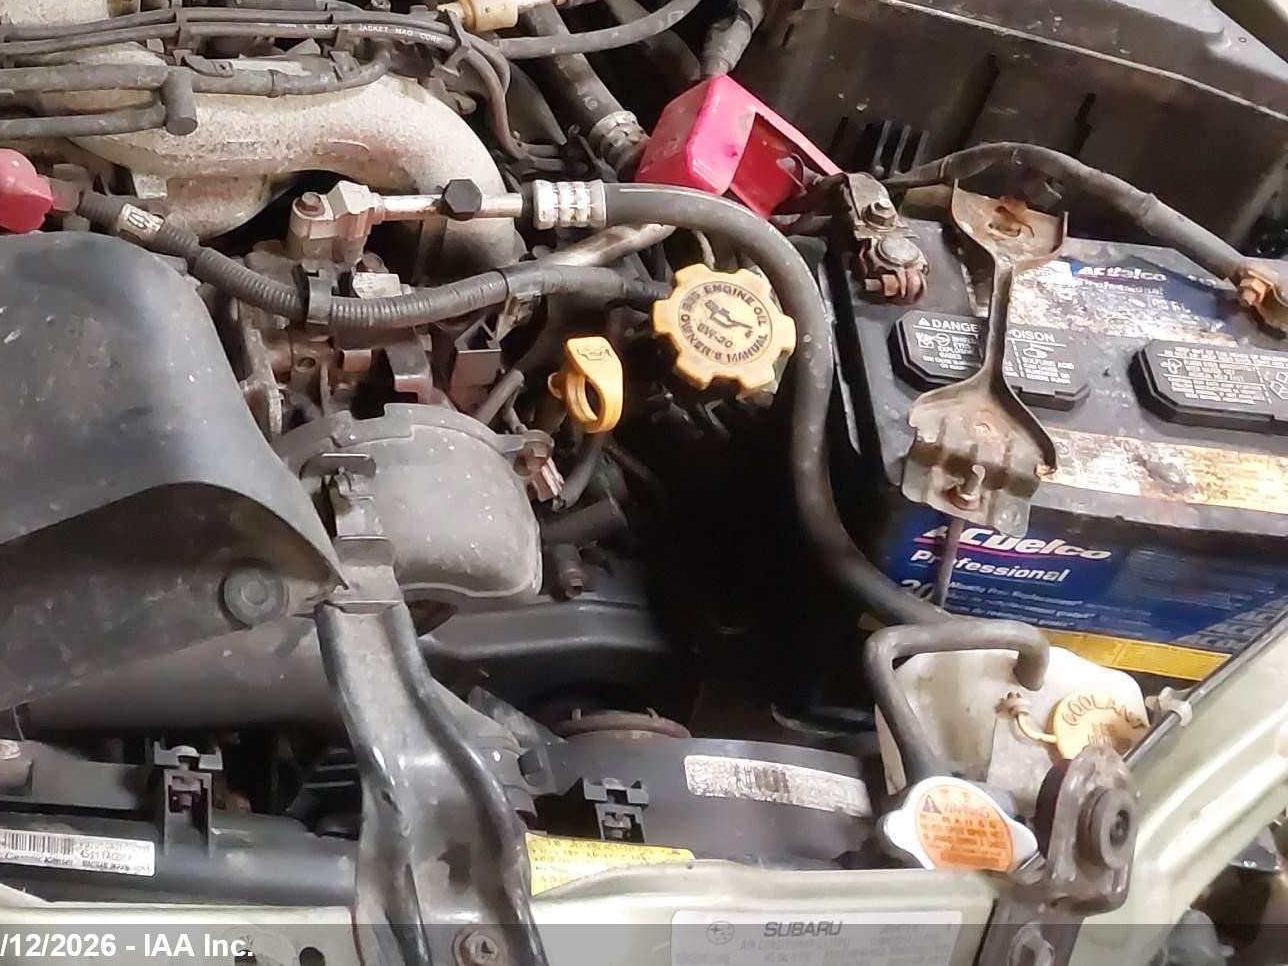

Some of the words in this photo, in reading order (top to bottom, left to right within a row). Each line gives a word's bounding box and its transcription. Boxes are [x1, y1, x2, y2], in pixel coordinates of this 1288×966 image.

[704, 284, 755, 306] ENGINE
[753, 306, 767, 327] OIL
[931, 318, 980, 334] DANGE
[763, 920, 843, 937] SUBARU
